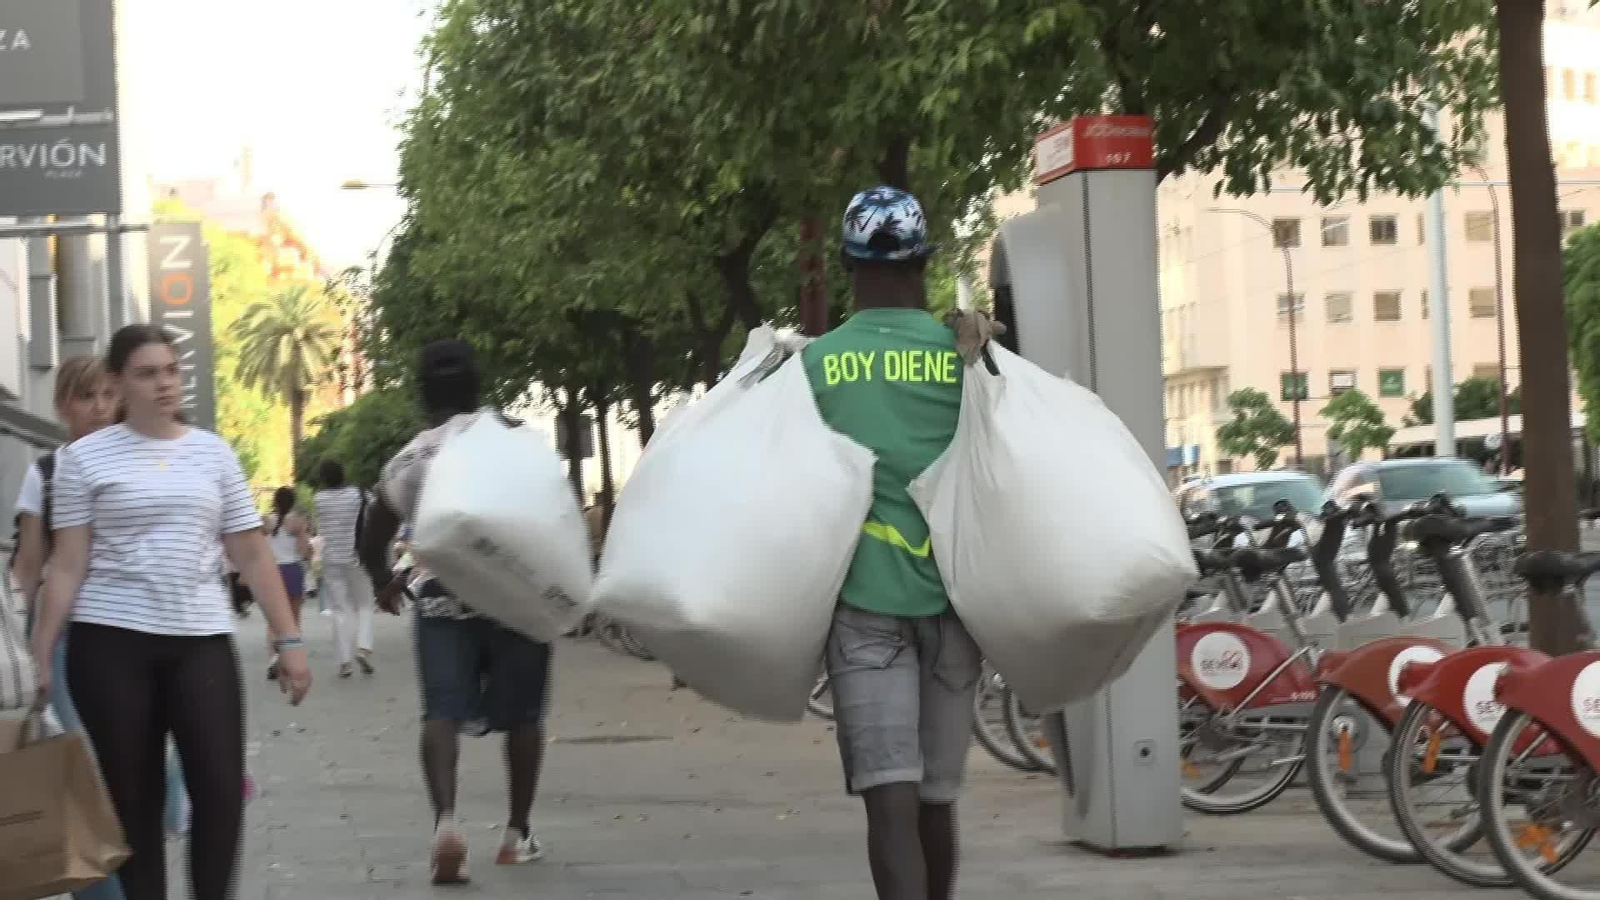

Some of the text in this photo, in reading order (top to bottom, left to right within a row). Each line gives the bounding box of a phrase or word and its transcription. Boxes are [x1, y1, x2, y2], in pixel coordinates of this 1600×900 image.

[0, 137, 107, 168] RVIÓN
[159, 234, 197, 410] VION
[823, 350, 957, 386] BOY DIENE
